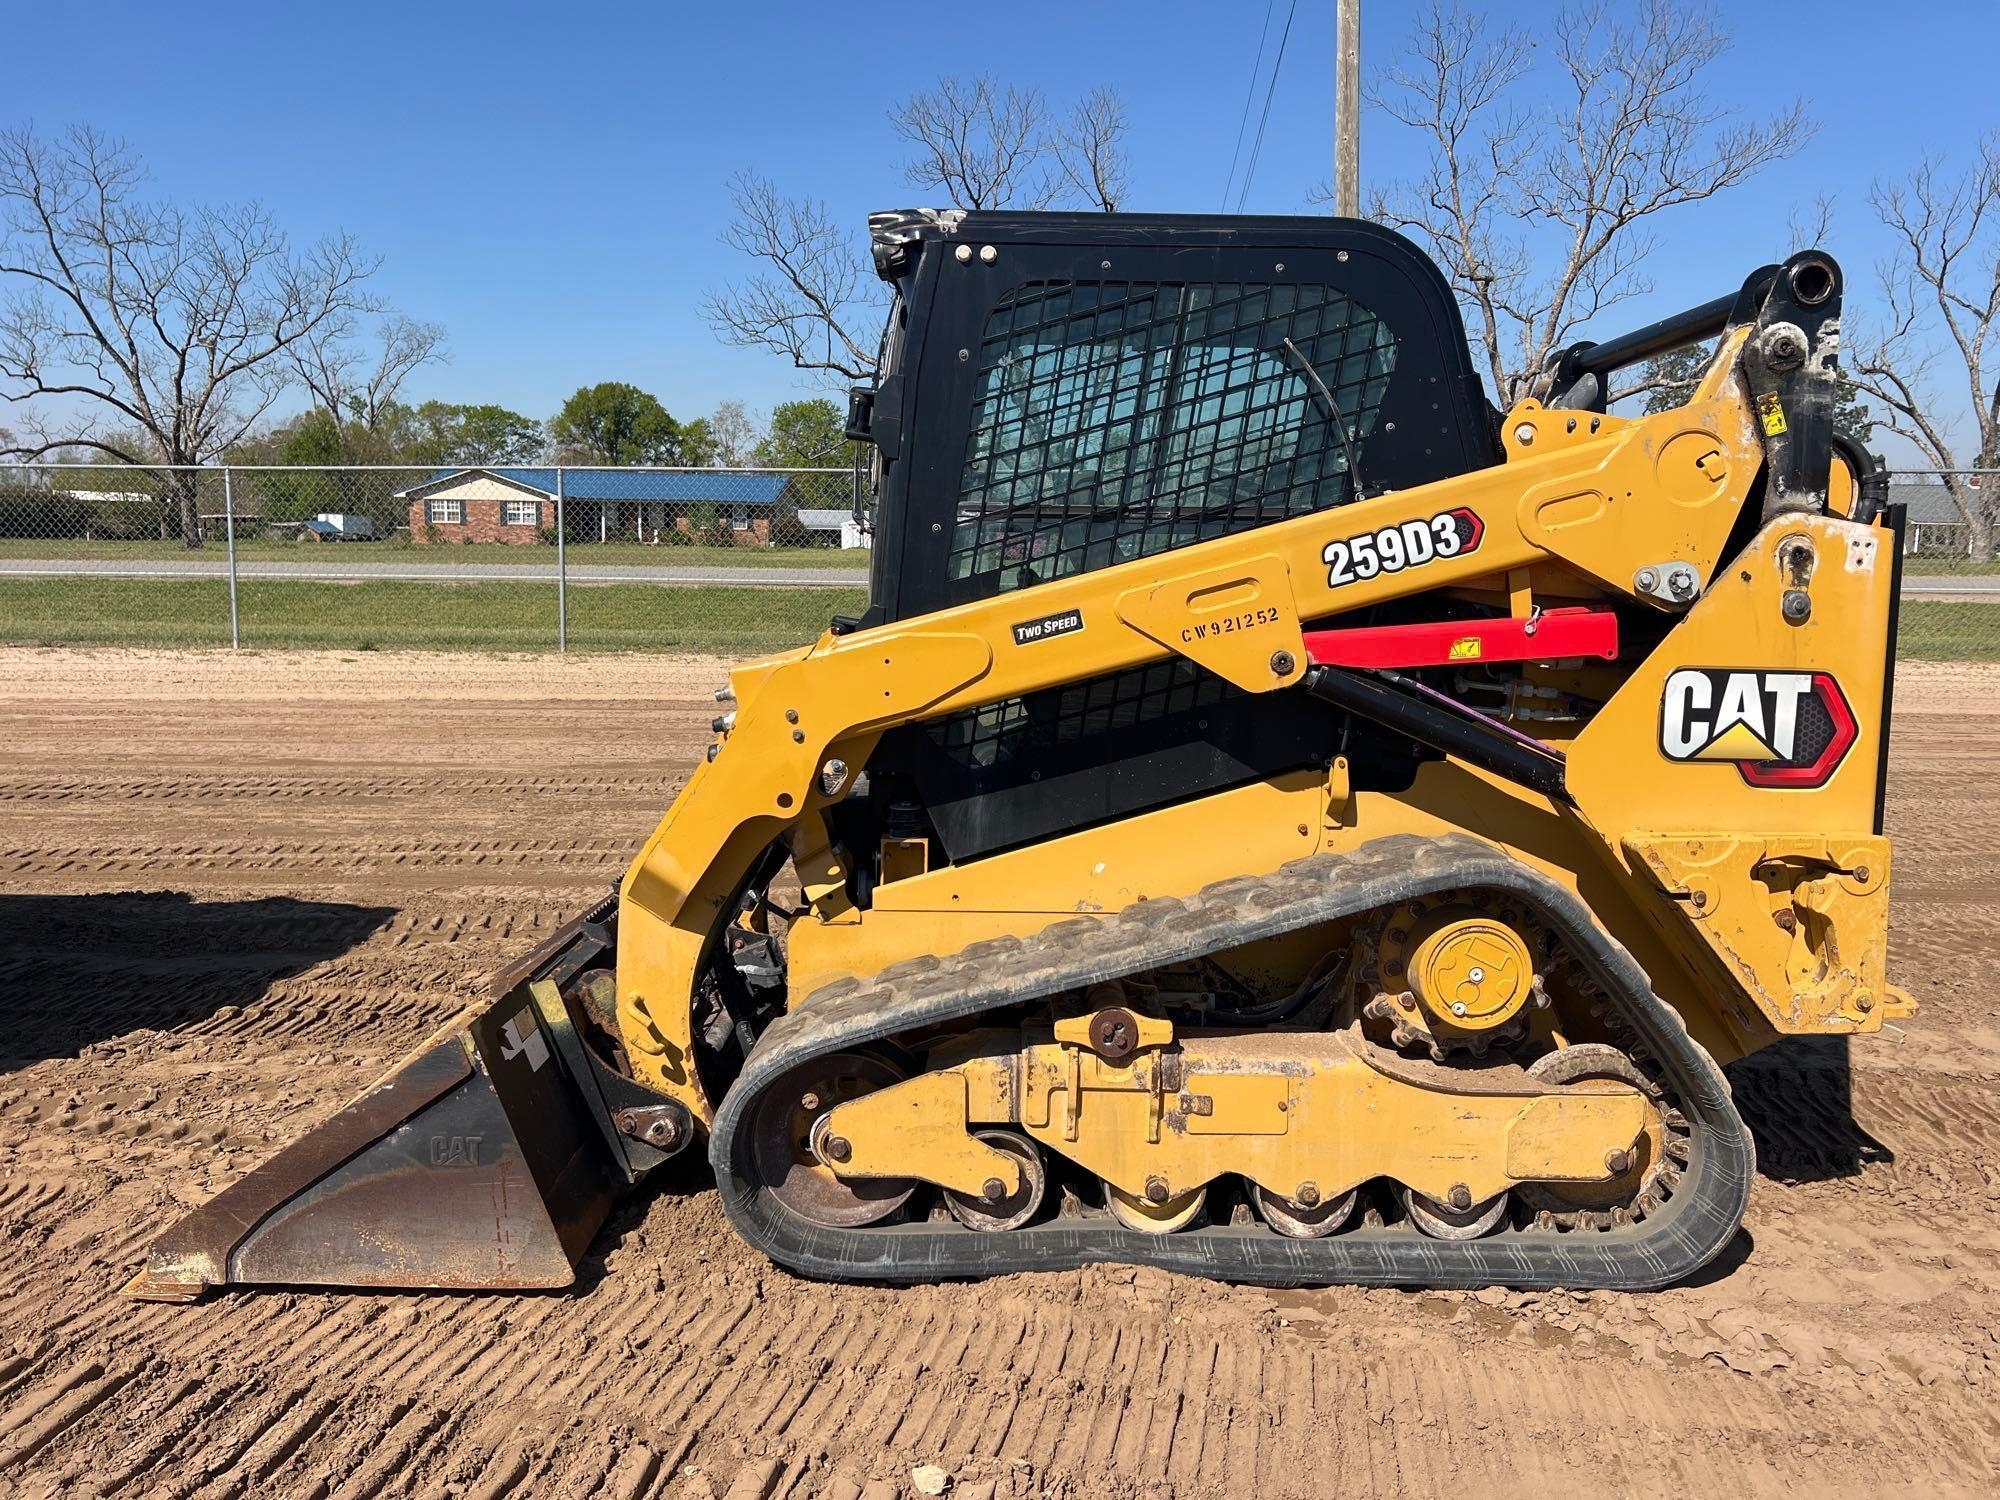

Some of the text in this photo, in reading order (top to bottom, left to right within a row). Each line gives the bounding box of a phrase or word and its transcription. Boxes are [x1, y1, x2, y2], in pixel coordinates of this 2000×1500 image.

[1324, 514, 1461, 586] 259D3
[1017, 616, 1078, 640] TWO SPEED
[1182, 607, 1279, 643] CW921252
[1663, 670, 1812, 760] CAT
[431, 1135, 482, 1168] CAT
